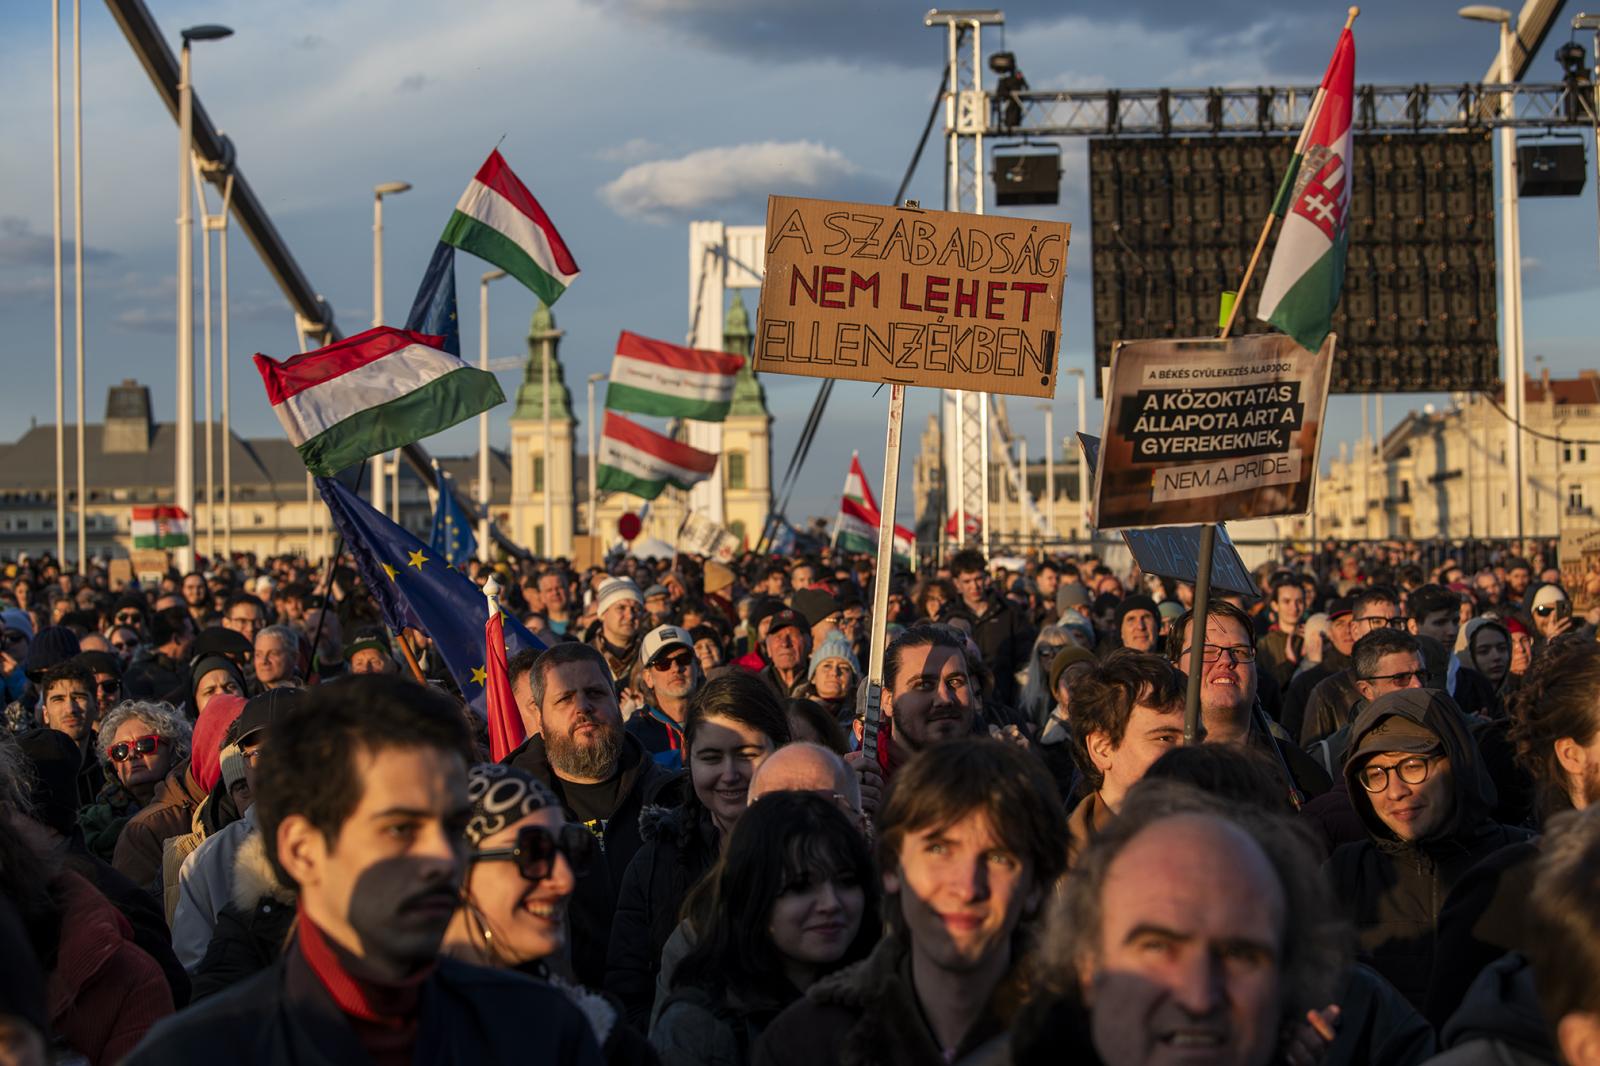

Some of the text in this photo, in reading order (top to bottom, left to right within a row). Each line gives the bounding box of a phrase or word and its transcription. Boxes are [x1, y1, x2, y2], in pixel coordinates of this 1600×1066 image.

[768, 208, 1061, 278] A SZABADSÁG
[789, 264, 1049, 322] NEM LEHET
[760, 316, 1056, 386] ELLENZÉKBEN!
[1149, 370, 1157, 379] A
[1158, 368, 1190, 379] BÉKÉS
[1192, 365, 1249, 378] GYÜLEKEZÉS
[1143, 385, 1292, 410] A KÖZOKTATÁS
[1133, 407, 1295, 432] ÁLLAPOTA ÁRT A
[1141, 429, 1283, 454] GYEREKEKNEK,
[1163, 456, 1292, 490] NEM A PRIDE.
